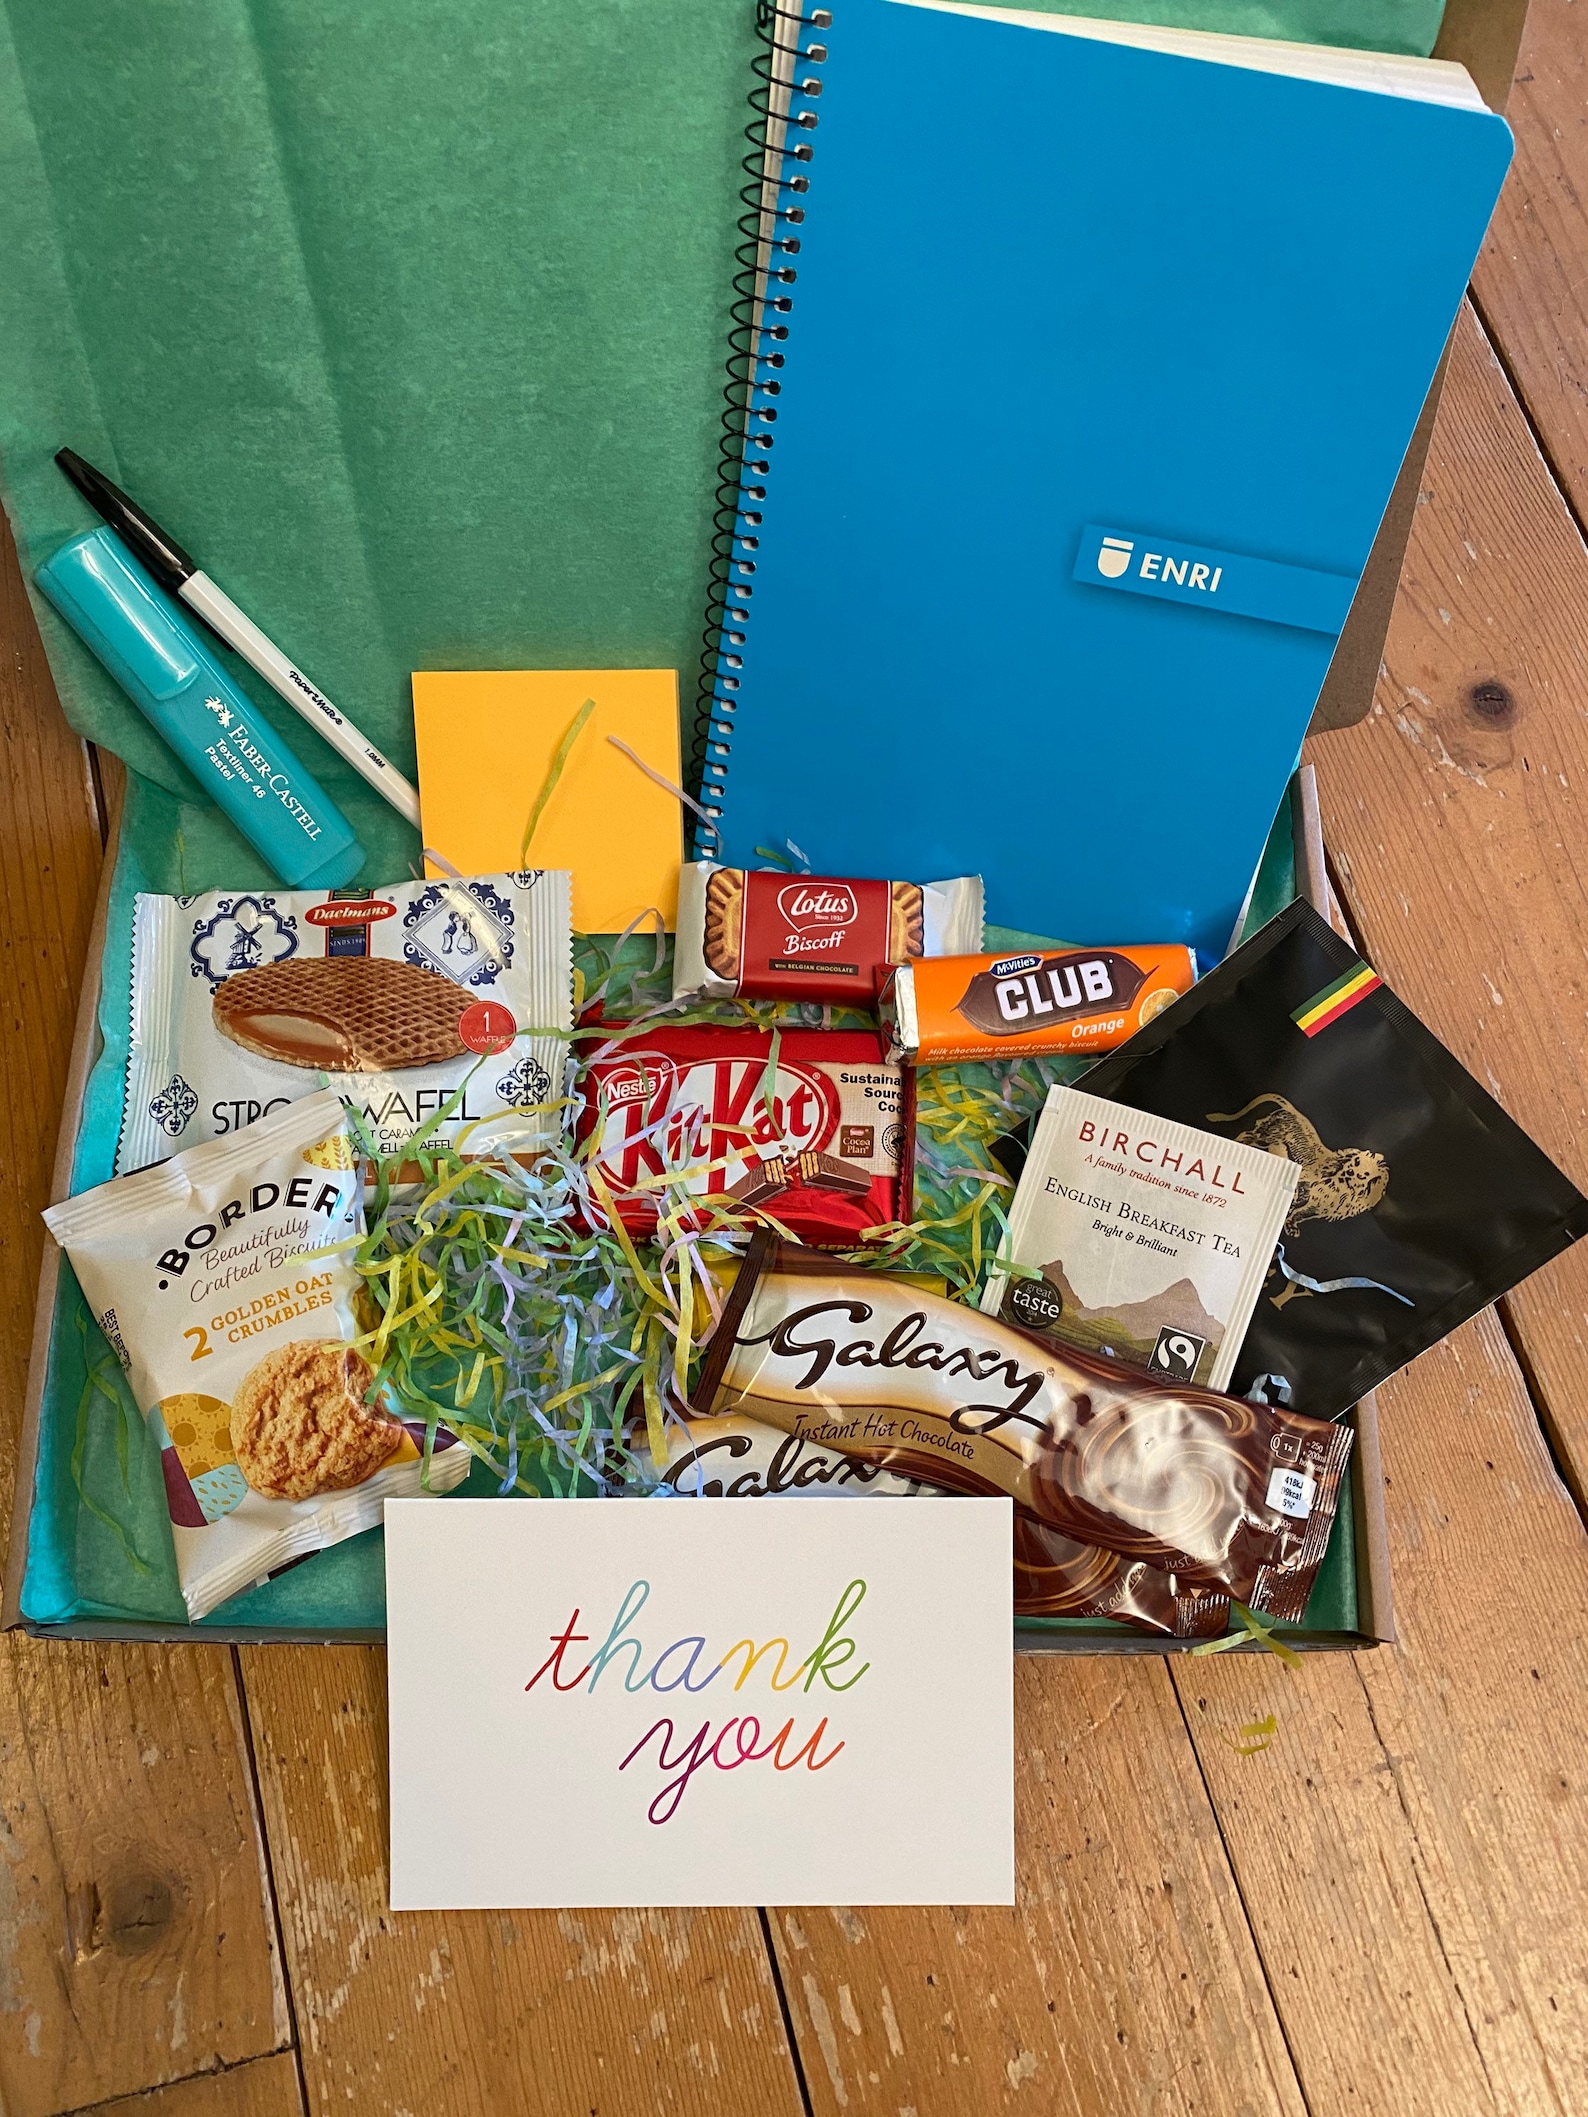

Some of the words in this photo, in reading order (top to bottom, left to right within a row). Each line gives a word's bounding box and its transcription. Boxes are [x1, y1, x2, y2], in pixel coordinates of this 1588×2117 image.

[1139, 552, 1223, 593] ENRI
[204, 746, 235, 781] Pastel
[215, 738, 253, 784] Textliner
[252, 785, 266, 799] 46
[228, 724, 322, 841] FABER-CASTELL
[313, 906, 390, 920] Daelmans
[790, 889, 849, 916] Lotus
[814, 913, 829, 921] Since
[830, 914, 844, 922] 1932
[782, 930, 846, 955] Biscoff
[788, 963, 815, 971] BELGIAN
[816, 965, 854, 974] CHOCOLATE
[996, 957, 1036, 975] McVitie's
[994, 959, 1113, 1021] CLUB
[483, 1011, 490, 1033] 1
[1071, 1017, 1125, 1039] Orange
[928, 1048, 949, 1056] Milk
[949, 1045, 994, 1055] chocolate
[994, 1043, 1031, 1052] covered
[1031, 1042, 1067, 1051] crunchy
[1068, 1040, 1098, 1048] biscuit
[212, 1089, 480, 1135] STRWAFEL
[842, 1136, 871, 1146] Cocoa
[1078, 1120, 1246, 1195] BIRCHALL
[1084, 1153, 1094, 1164] A
[1093, 1155, 1127, 1177] family
[1129, 1168, 1171, 1190] tradition
[1173, 1183, 1200, 1199] since
[1201, 1193, 1228, 1208] 1872
[154, 1178, 344, 1278] BORDER
[200, 1217, 311, 1271] Beautifully
[1092, 1219, 1124, 1241] Bright
[1125, 1231, 1135, 1242] &
[1135, 1234, 1178, 1258] Brilliant
[190, 1255, 262, 1303] Crafted
[264, 1234, 336, 1269] Biscuits
[1012, 1288, 1060, 1318] taste
[1025, 1283, 1052, 1299] great
[104, 1308, 120, 1334] BEST
[183, 1326, 213, 1362] 2
[211, 1287, 290, 1331] GOLDEN
[295, 1272, 333, 1295] OAT
[228, 1290, 333, 1343] CRUMBLES
[734, 1299, 1054, 1435] Galaxy
[794, 1413, 858, 1442] Instant
[863, 1413, 898, 1439] Hot
[900, 1420, 975, 1460] Chocolate
[1283, 1443, 1294, 1452] 1x
[1163, 1554, 1191, 1571] just
[1080, 1601, 1107, 1618] just
[524, 1579, 871, 1694] thank
[619, 1716, 846, 1825] you
